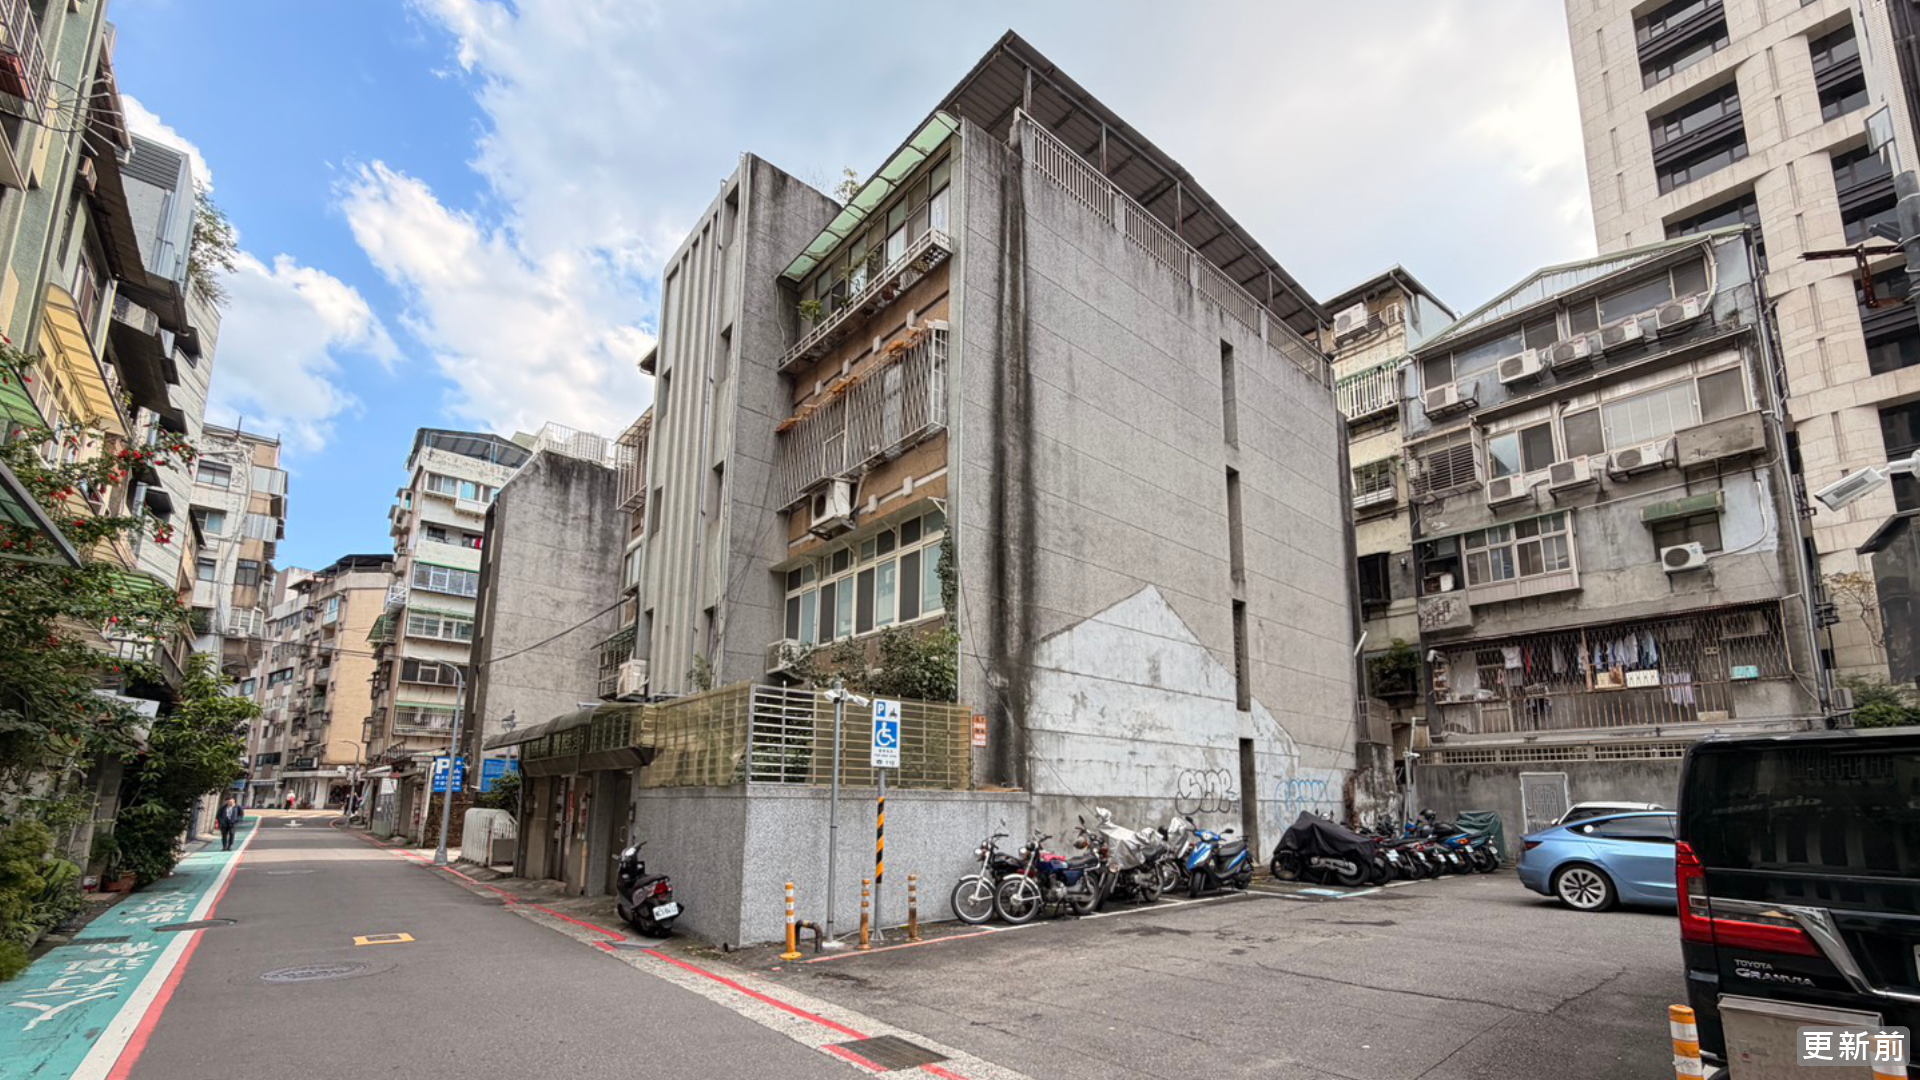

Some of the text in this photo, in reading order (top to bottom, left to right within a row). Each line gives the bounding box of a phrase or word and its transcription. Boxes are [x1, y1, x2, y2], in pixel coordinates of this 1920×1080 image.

[878, 703, 885, 715] P
[437, 758, 450, 774] P
[1734, 959, 1774, 971] TOYOTA
[1735, 967, 1817, 988] GRANVIA
